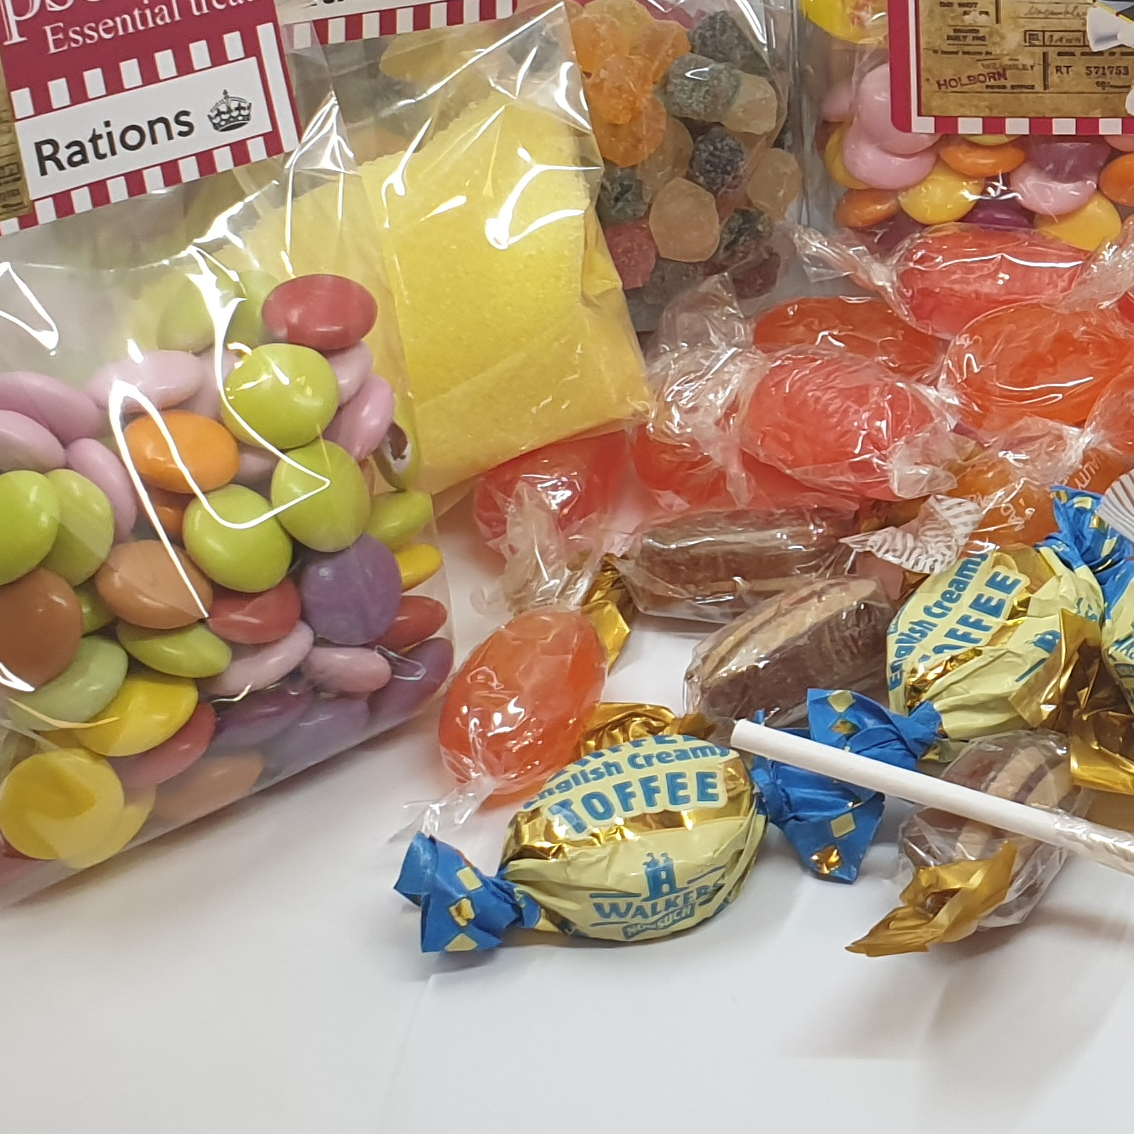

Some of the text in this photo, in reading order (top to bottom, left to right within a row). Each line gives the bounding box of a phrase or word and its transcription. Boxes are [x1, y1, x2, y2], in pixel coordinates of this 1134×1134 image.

[935, 68, 1009, 91] HOLBORN
[34, 107, 196, 178] Rations
[918, 570, 1023, 663] OFFEE
[627, 742, 732, 771] Creamy
[547, 770, 721, 835] TOFFEE
